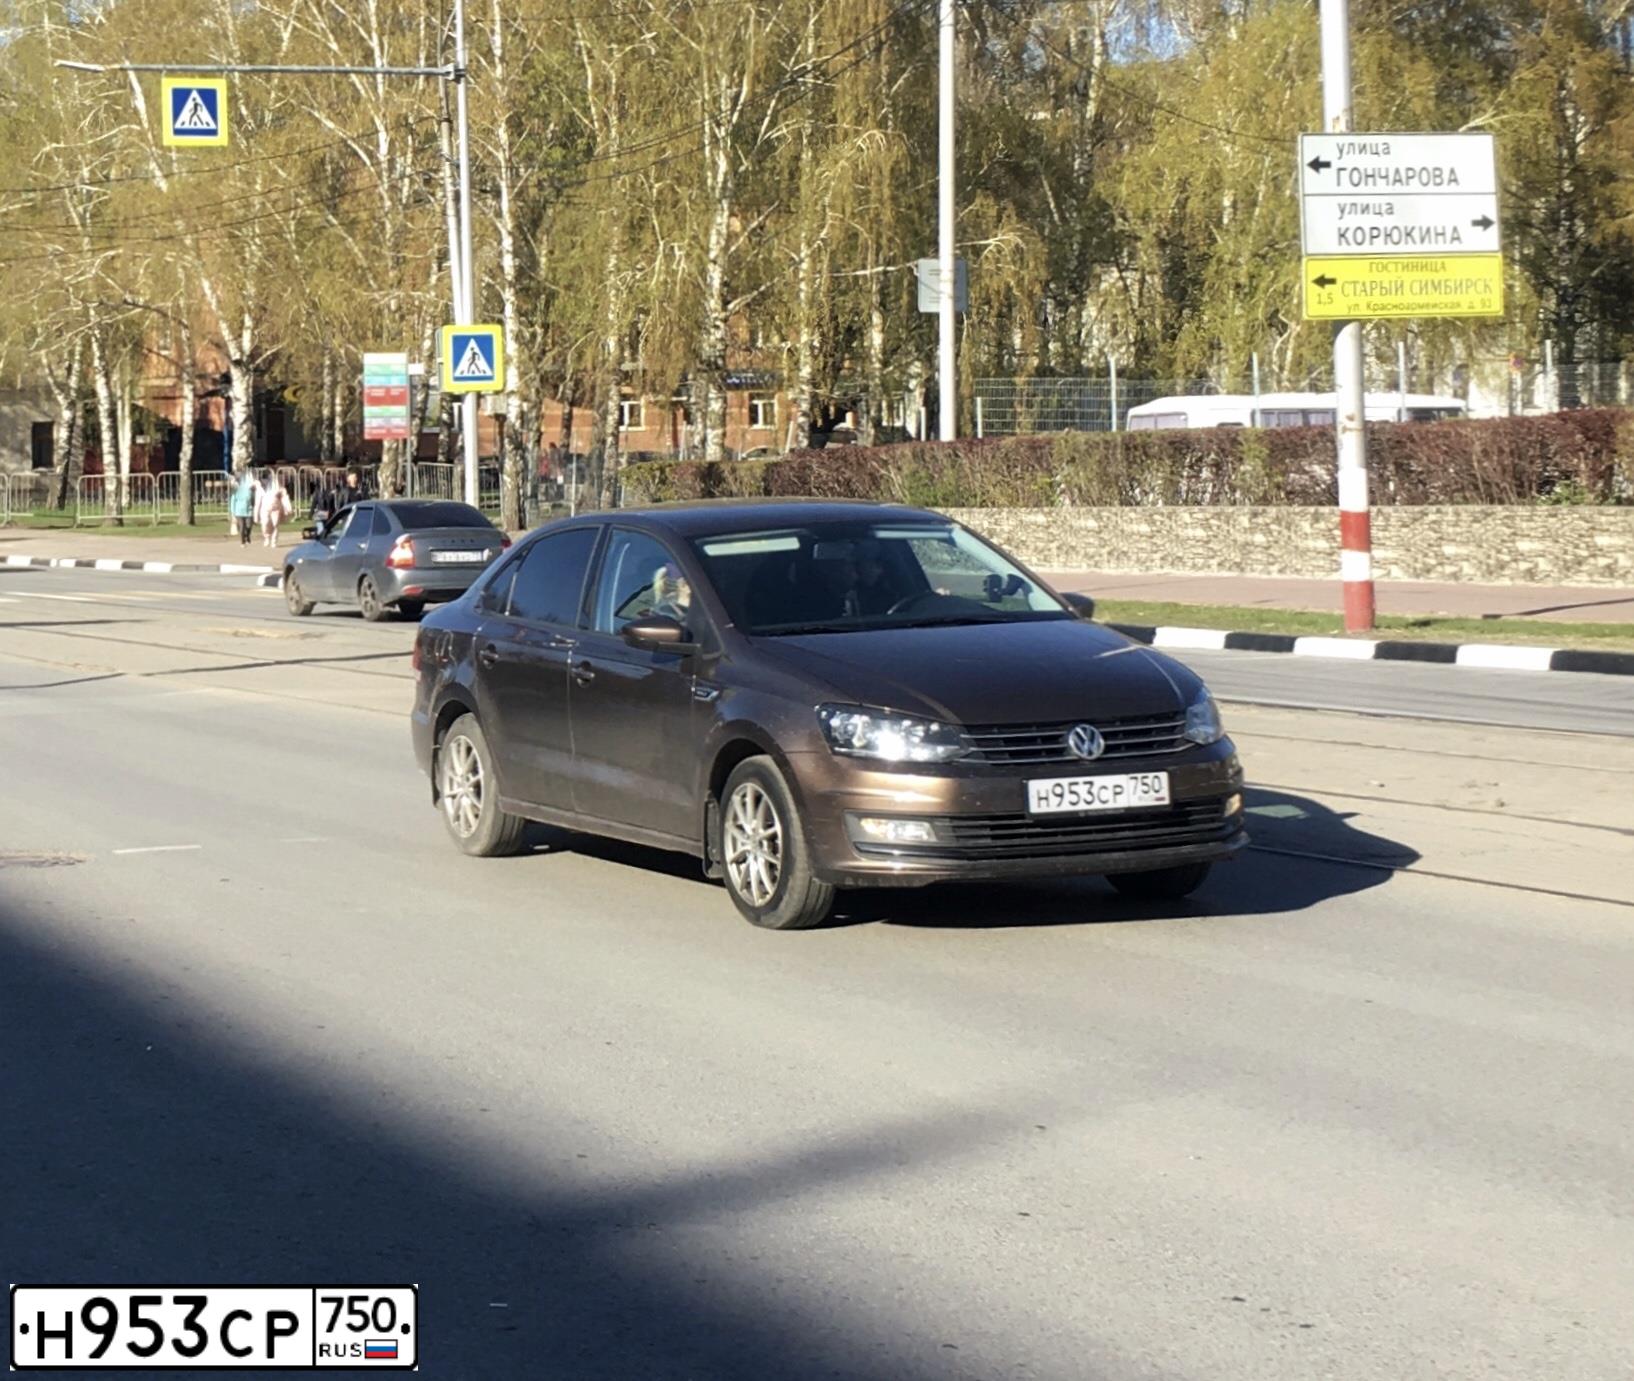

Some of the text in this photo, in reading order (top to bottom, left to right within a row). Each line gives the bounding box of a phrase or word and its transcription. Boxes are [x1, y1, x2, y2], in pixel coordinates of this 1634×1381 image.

[1336, 142, 1391, 160] улица
[1336, 167, 1460, 187] ГОНЧАРОВА
[1337, 202, 1395, 220] улица
[1337, 225, 1463, 246] КОРЮКИНА
[1369, 261, 1447, 273] ГОСТИНИЦА
[1341, 276, 1493, 297] СТАРЫЙ СИМБИРСК
[1316, 292, 1334, 306] 1,5
[1036, 780, 1124, 809] Н953СР
[1129, 775, 1162, 795] 750
